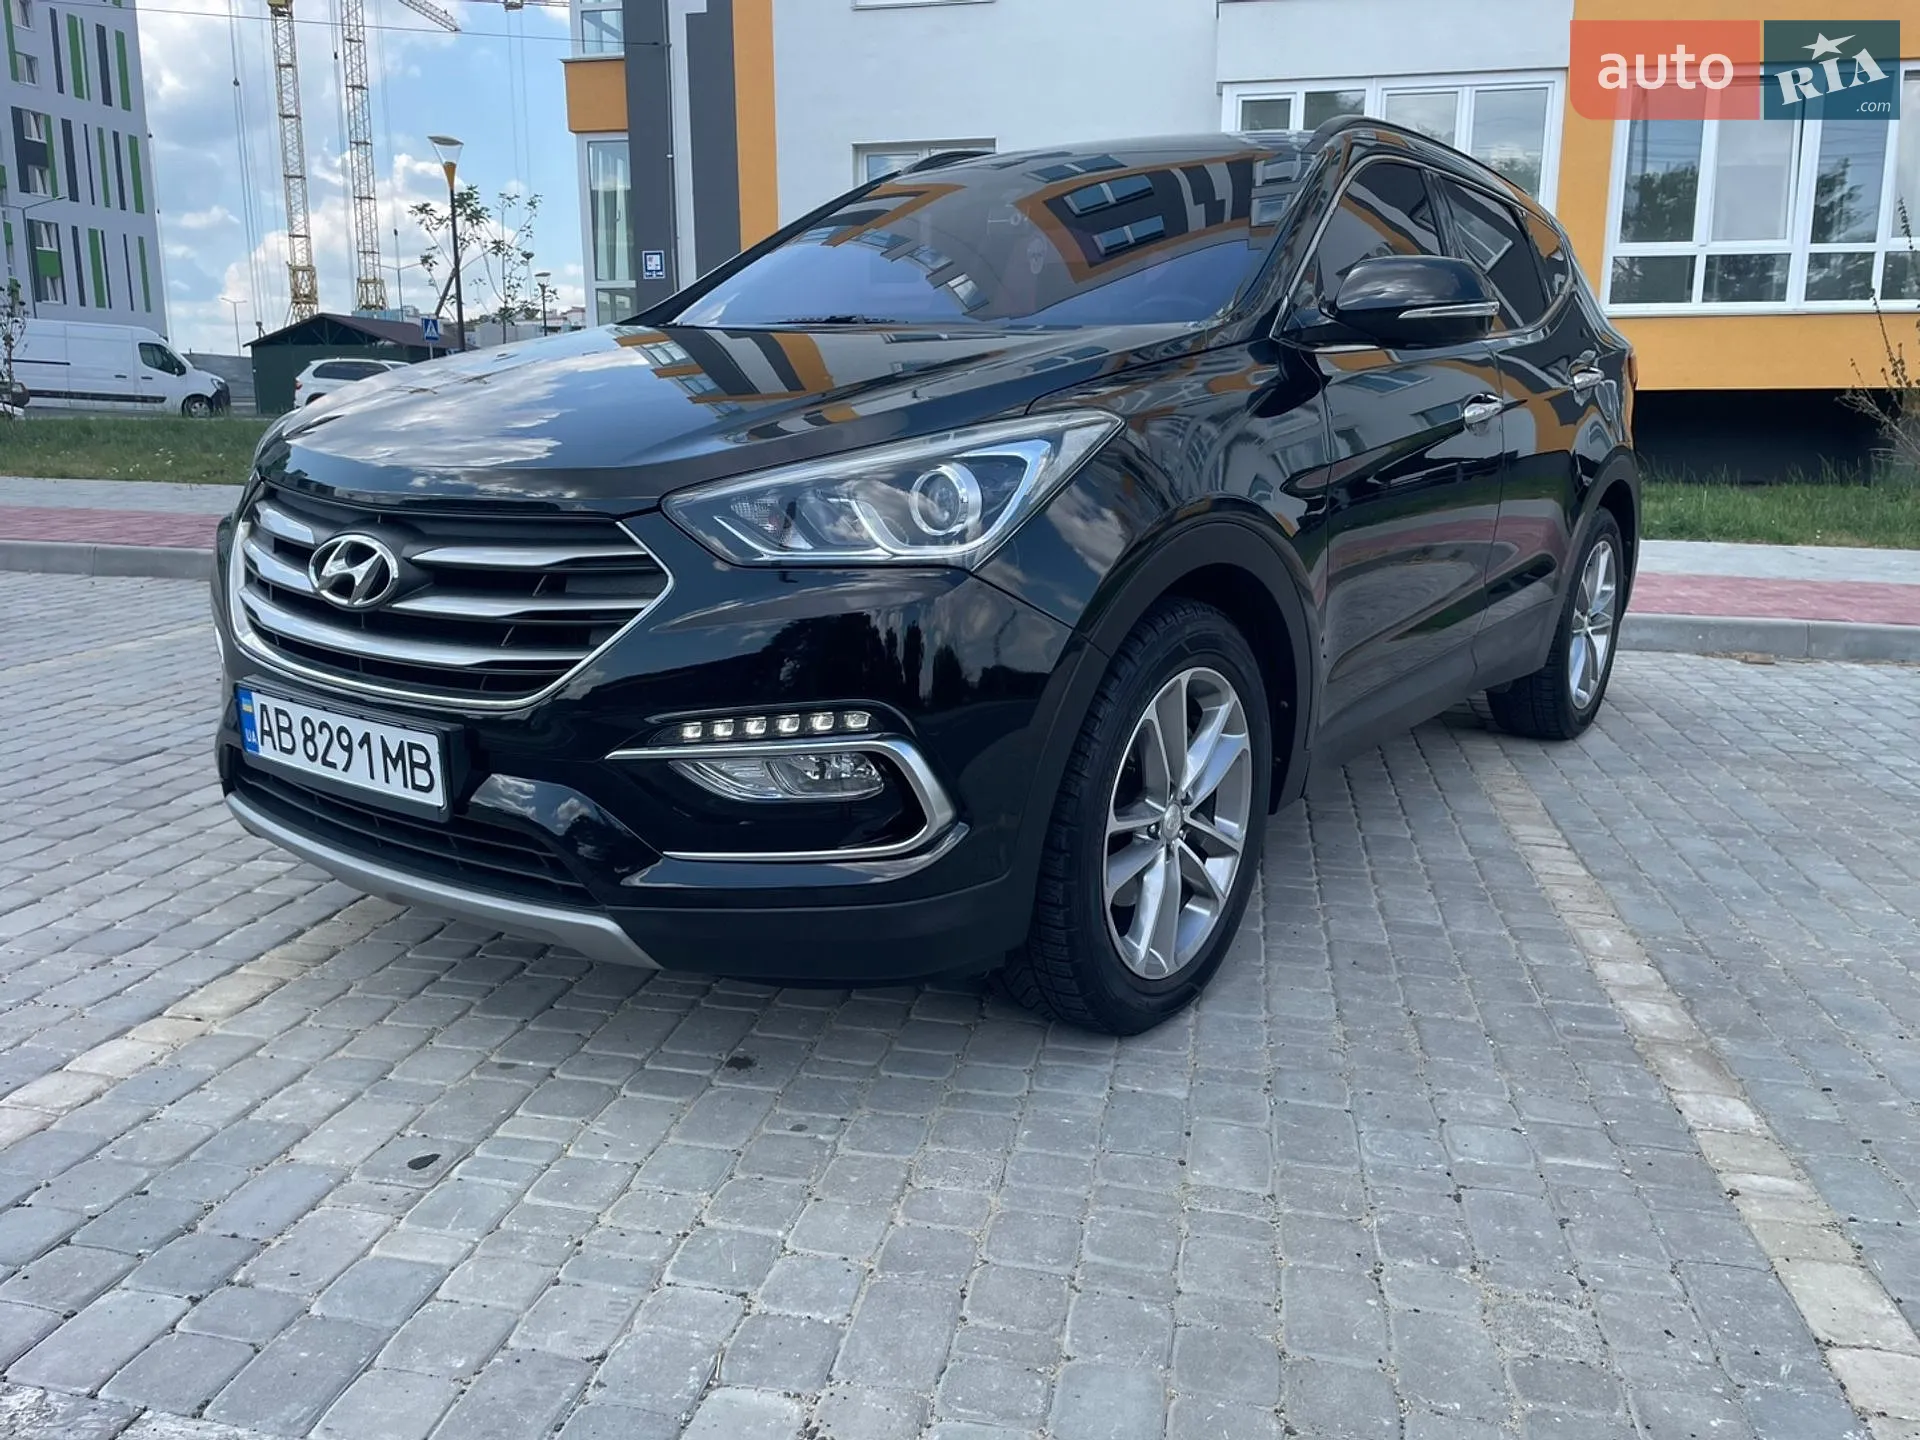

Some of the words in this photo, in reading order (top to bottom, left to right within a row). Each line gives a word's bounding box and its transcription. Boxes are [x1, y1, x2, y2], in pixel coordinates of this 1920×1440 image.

[245, 728, 257, 742] UA
[259, 703, 296, 755] AB
[301, 716, 375, 780] 8291
[380, 734, 435, 793] MB
